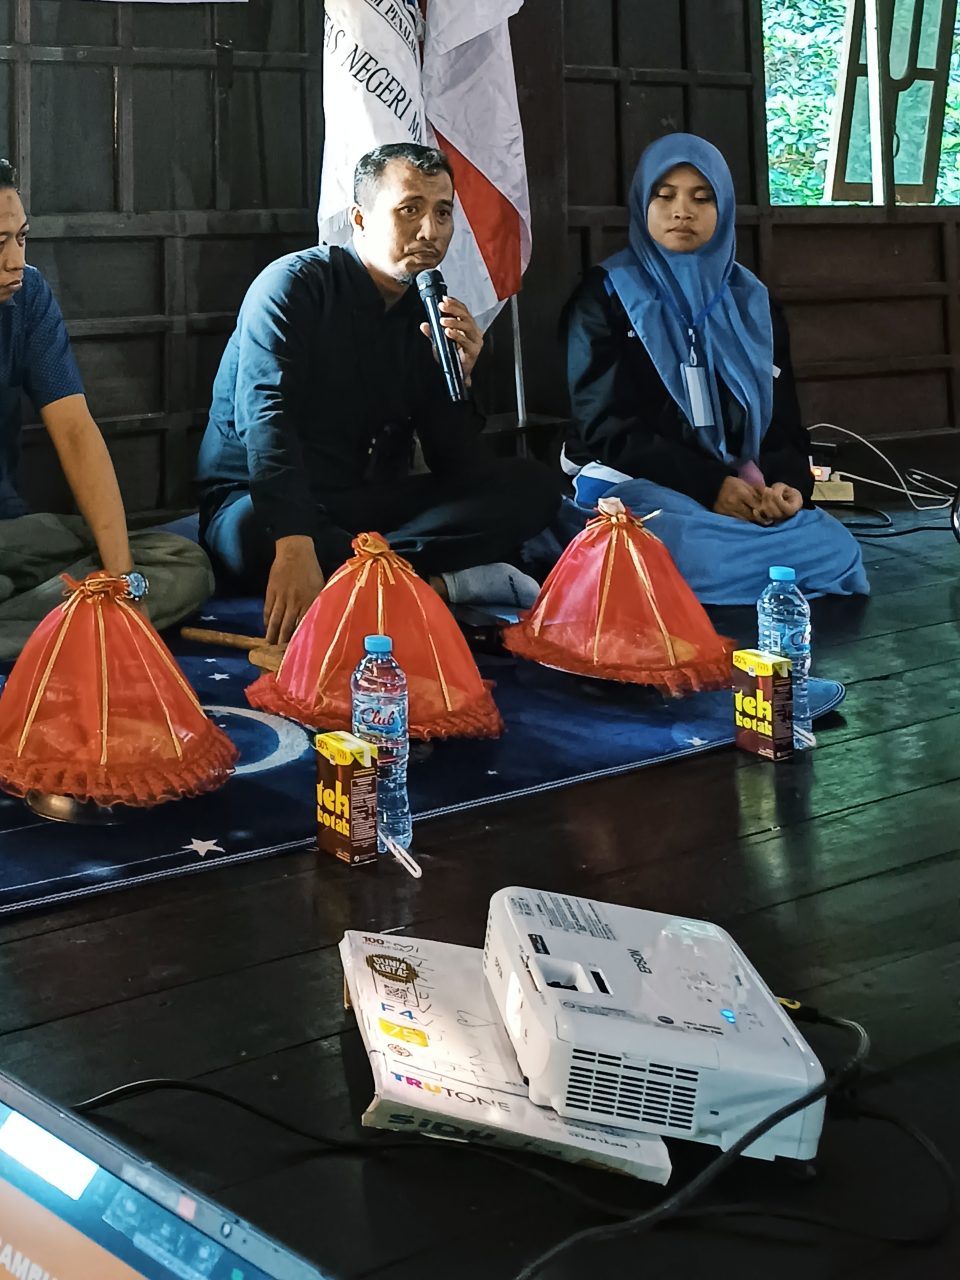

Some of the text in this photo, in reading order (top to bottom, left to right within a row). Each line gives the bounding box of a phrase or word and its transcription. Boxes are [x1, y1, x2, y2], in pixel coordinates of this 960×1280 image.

[341, 43, 413, 120] NEGERI
[360, 707, 395, 726] Club
[735, 689, 772, 721] teh
[316, 780, 349, 819] teh
[390, 1071, 511, 1112] TRUTONE
